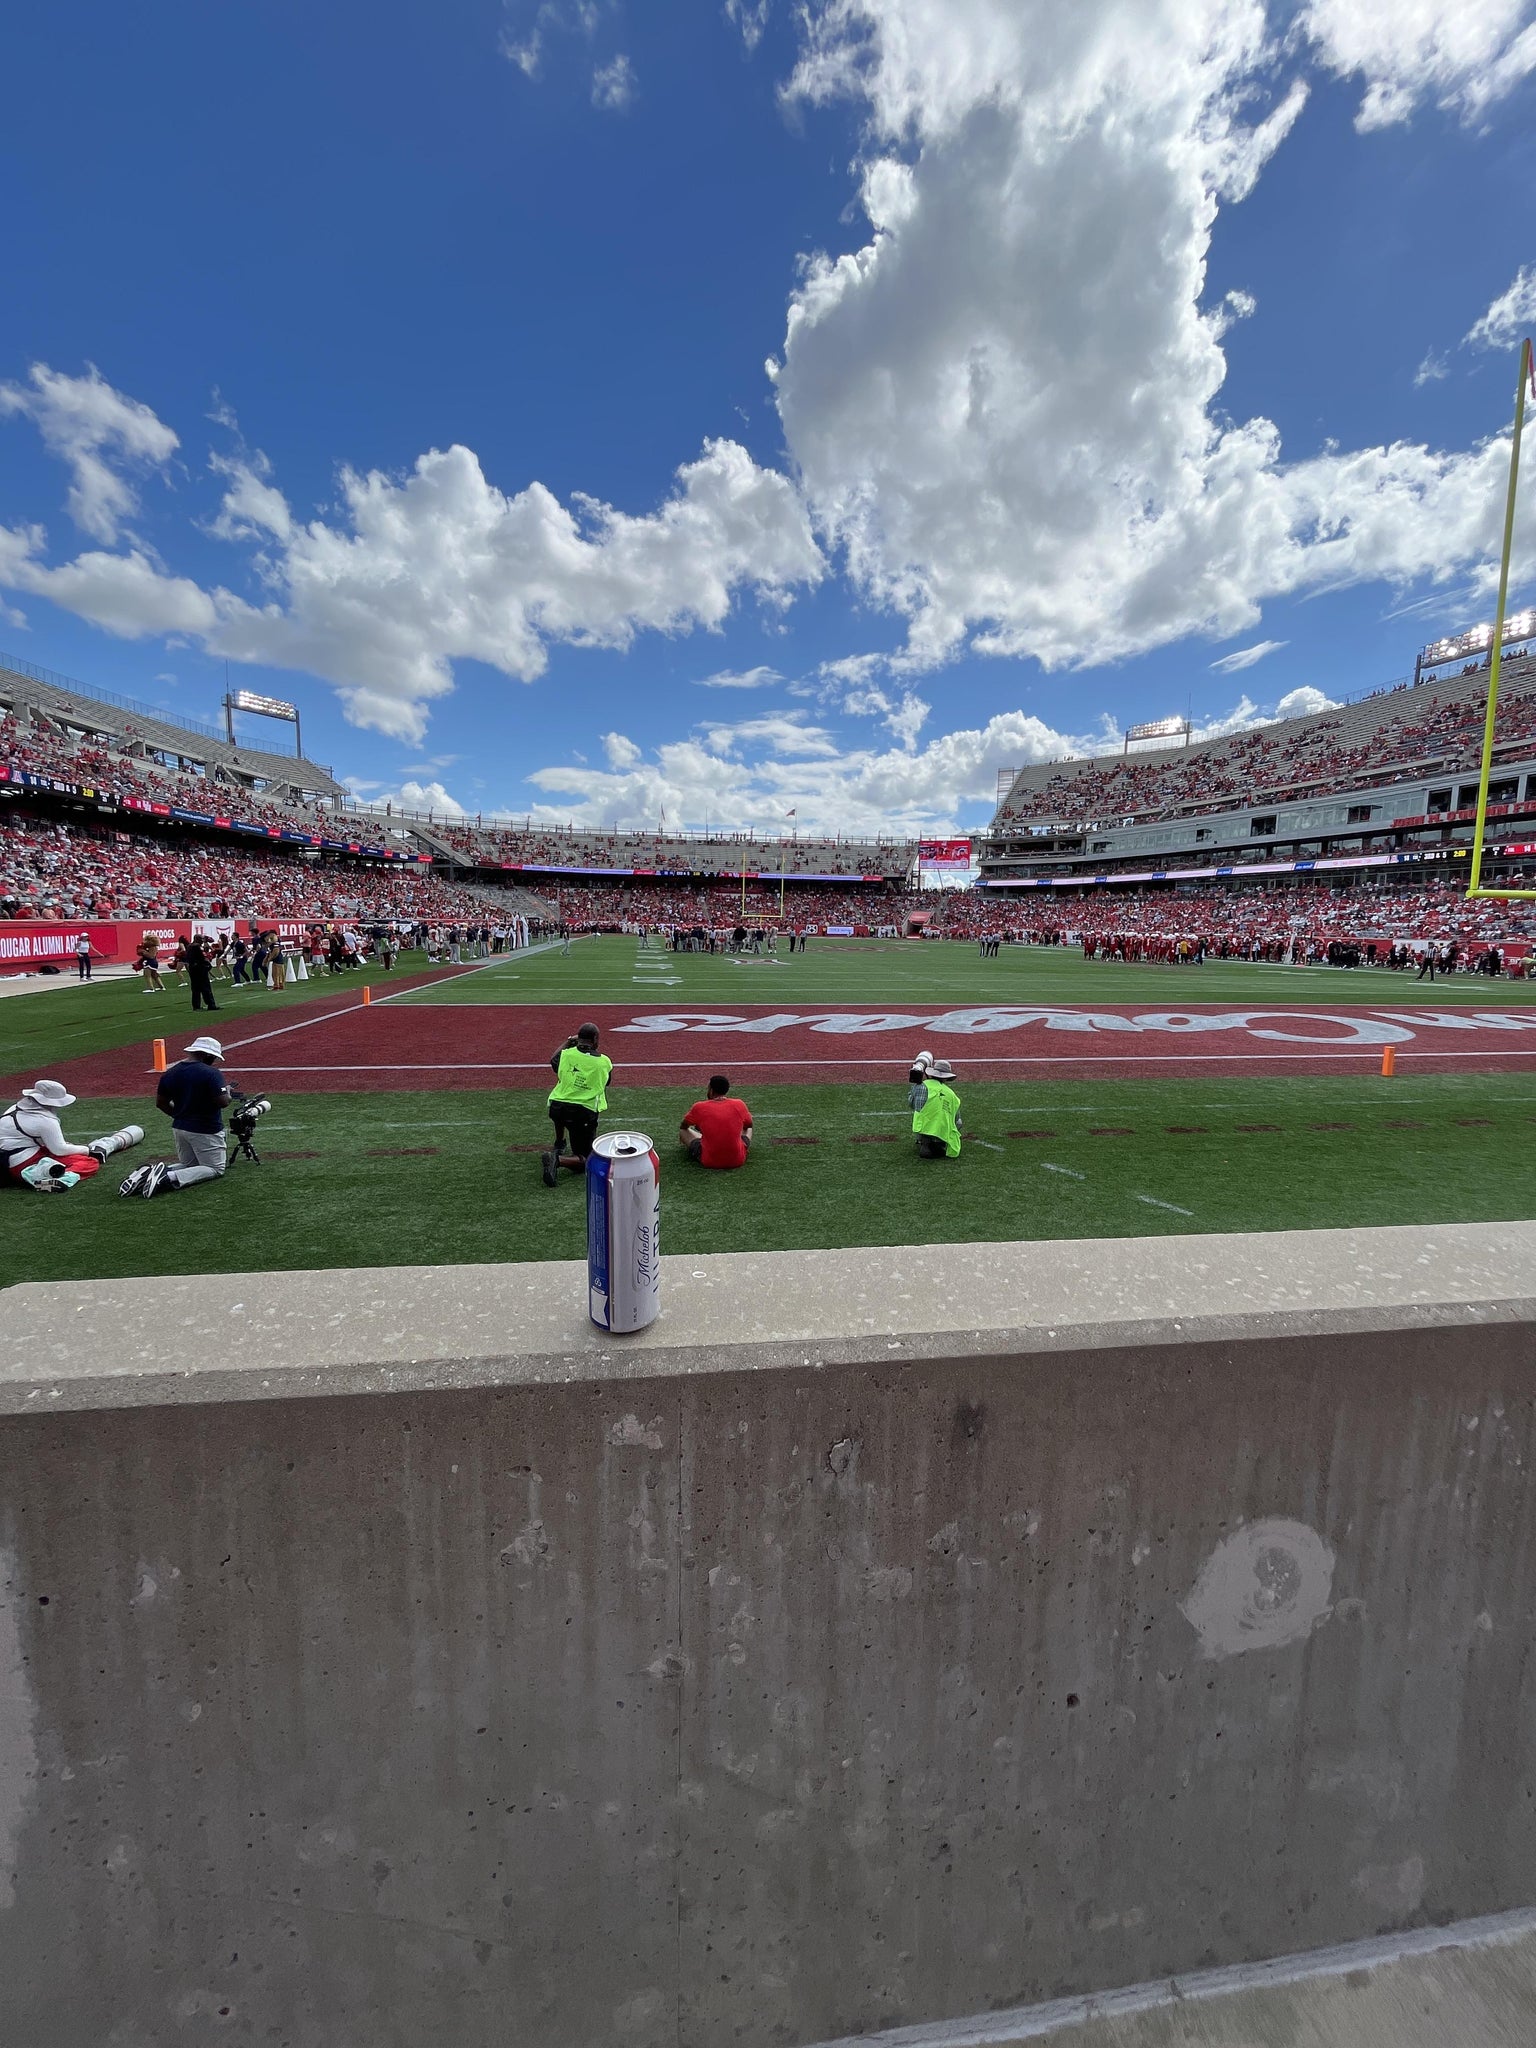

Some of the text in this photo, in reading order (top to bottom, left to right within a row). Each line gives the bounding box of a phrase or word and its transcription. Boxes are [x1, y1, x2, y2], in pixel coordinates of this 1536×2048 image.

[0, 938, 31, 958] OUGAR
[33, 935, 64, 956] ALUMNI
[609, 1008, 1416, 1044] Cougars
[636, 1225, 651, 1287] Michelob
